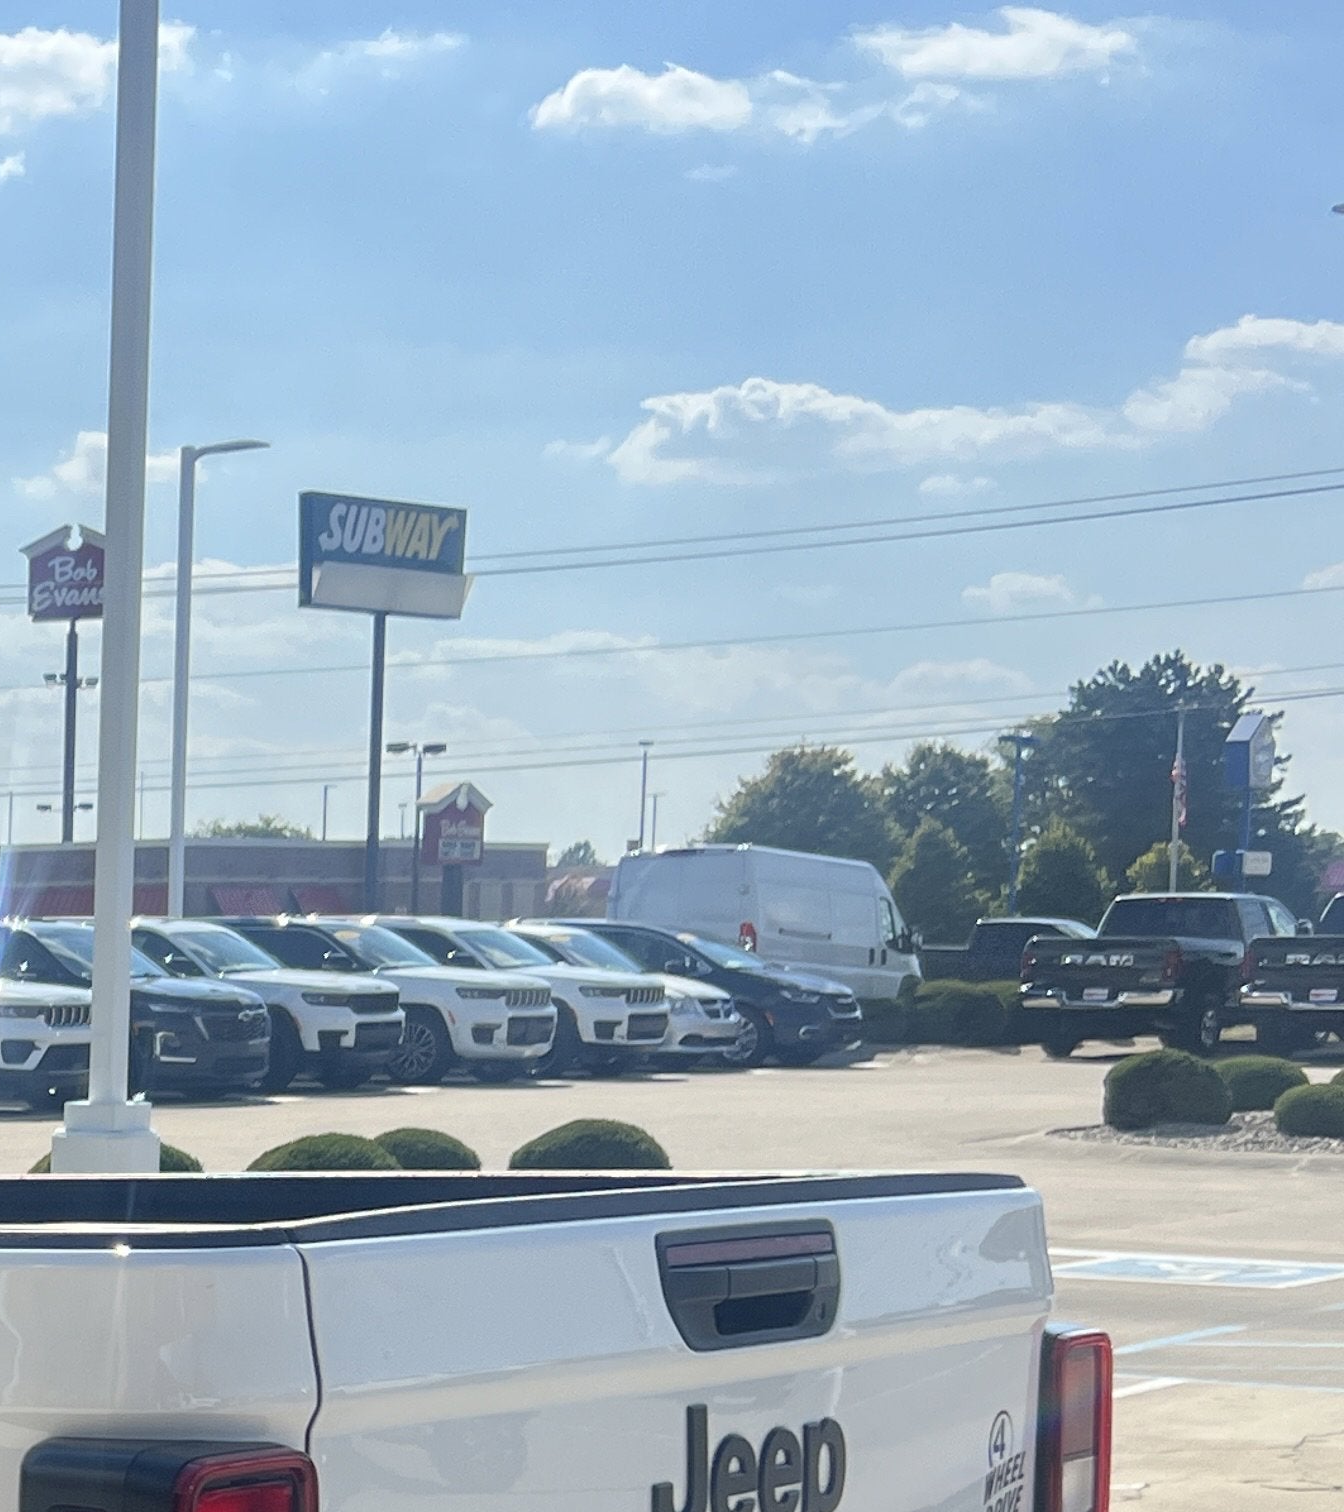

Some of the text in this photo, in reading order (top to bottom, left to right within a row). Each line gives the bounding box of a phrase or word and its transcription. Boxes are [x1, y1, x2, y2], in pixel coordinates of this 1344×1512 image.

[319, 502, 460, 560] SUBWAY
[48, 556, 97, 582] Bob
[1062, 954, 1134, 967] RAM
[1286, 953, 1344, 966] RA
[983, 1451, 1026, 1505] WHEEL
